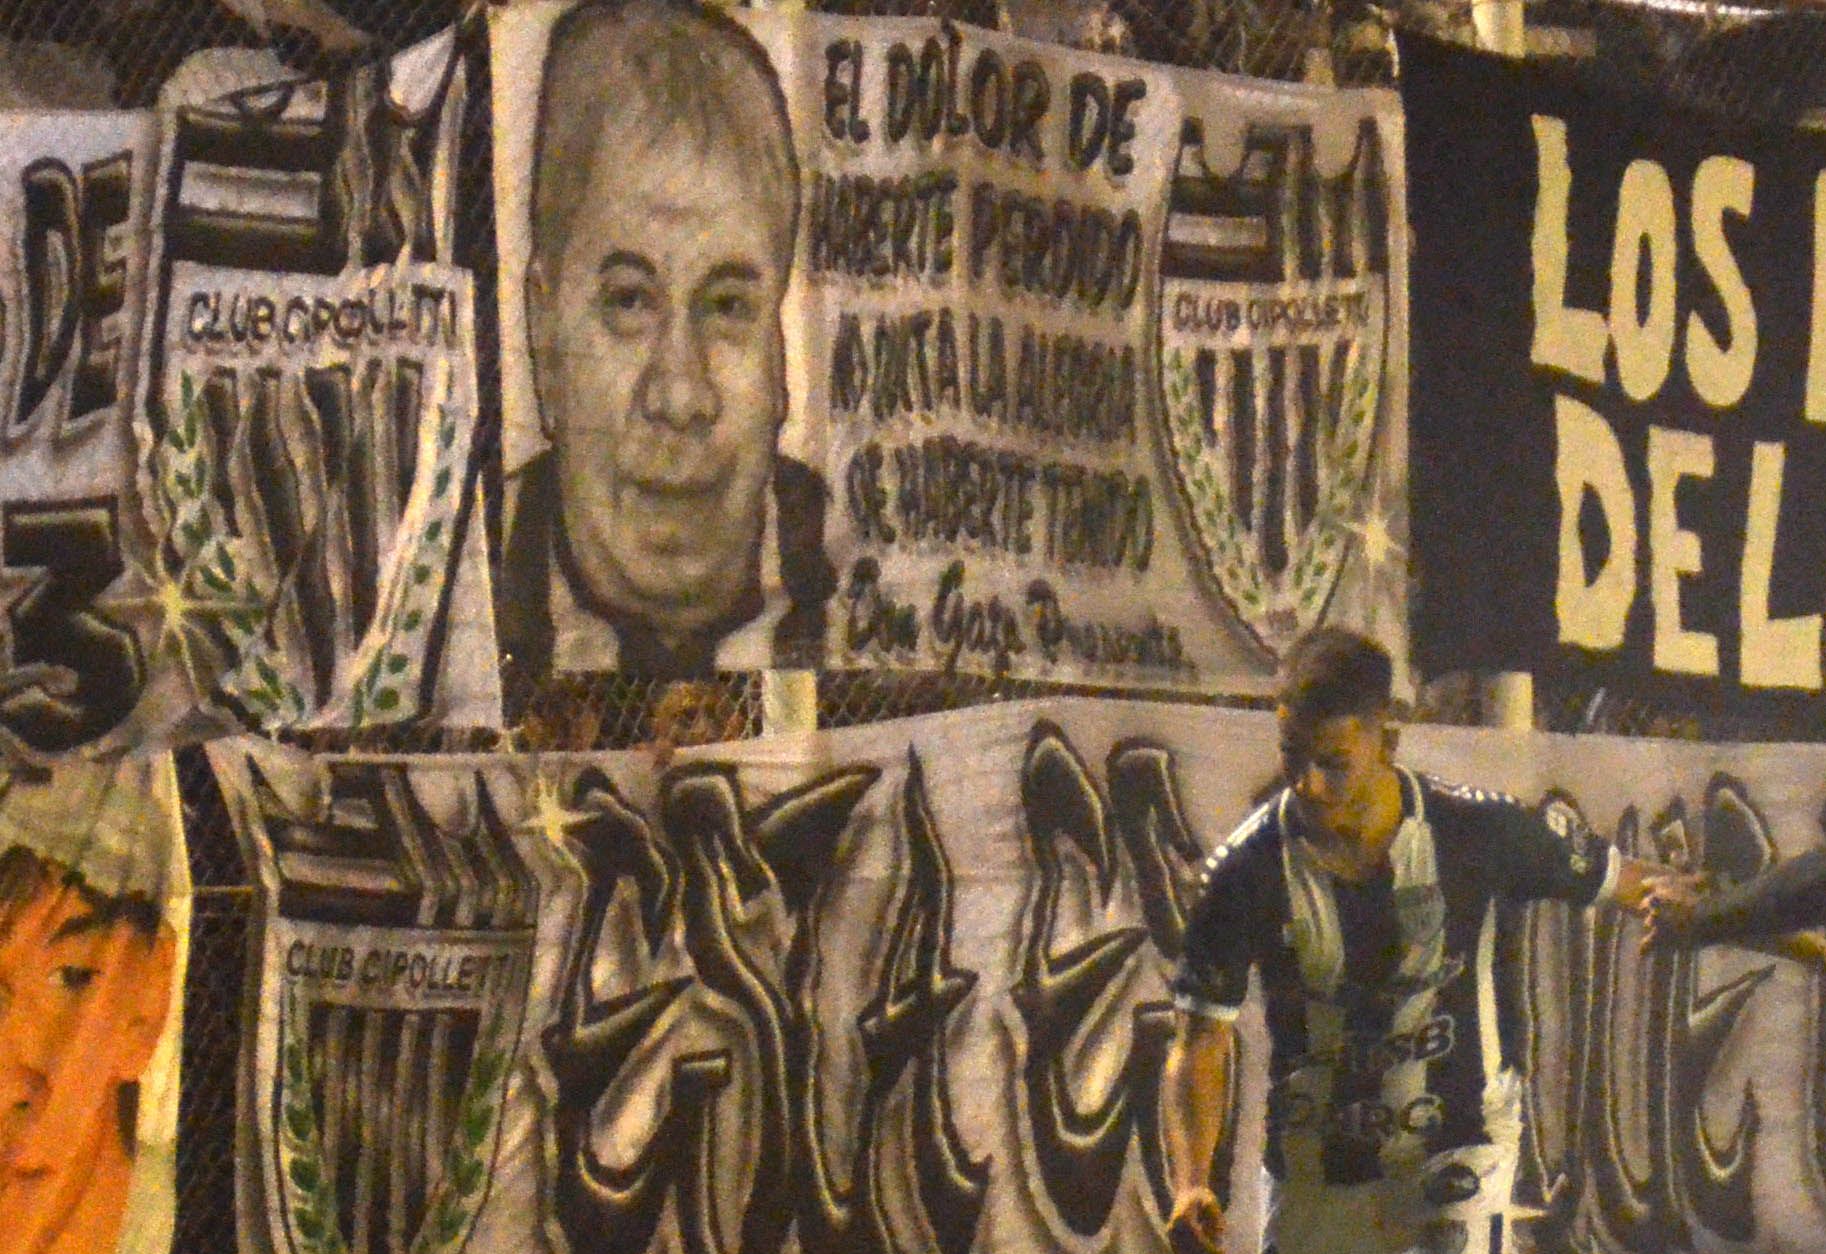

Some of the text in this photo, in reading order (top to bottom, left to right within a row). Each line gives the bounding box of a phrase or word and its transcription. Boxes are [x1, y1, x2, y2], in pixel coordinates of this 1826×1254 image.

[886, 18, 1050, 164] DOLOR
[1066, 70, 1147, 177] DE
[1530, 112, 1757, 408] LOS
[1553, 394, 1721, 677] DE
